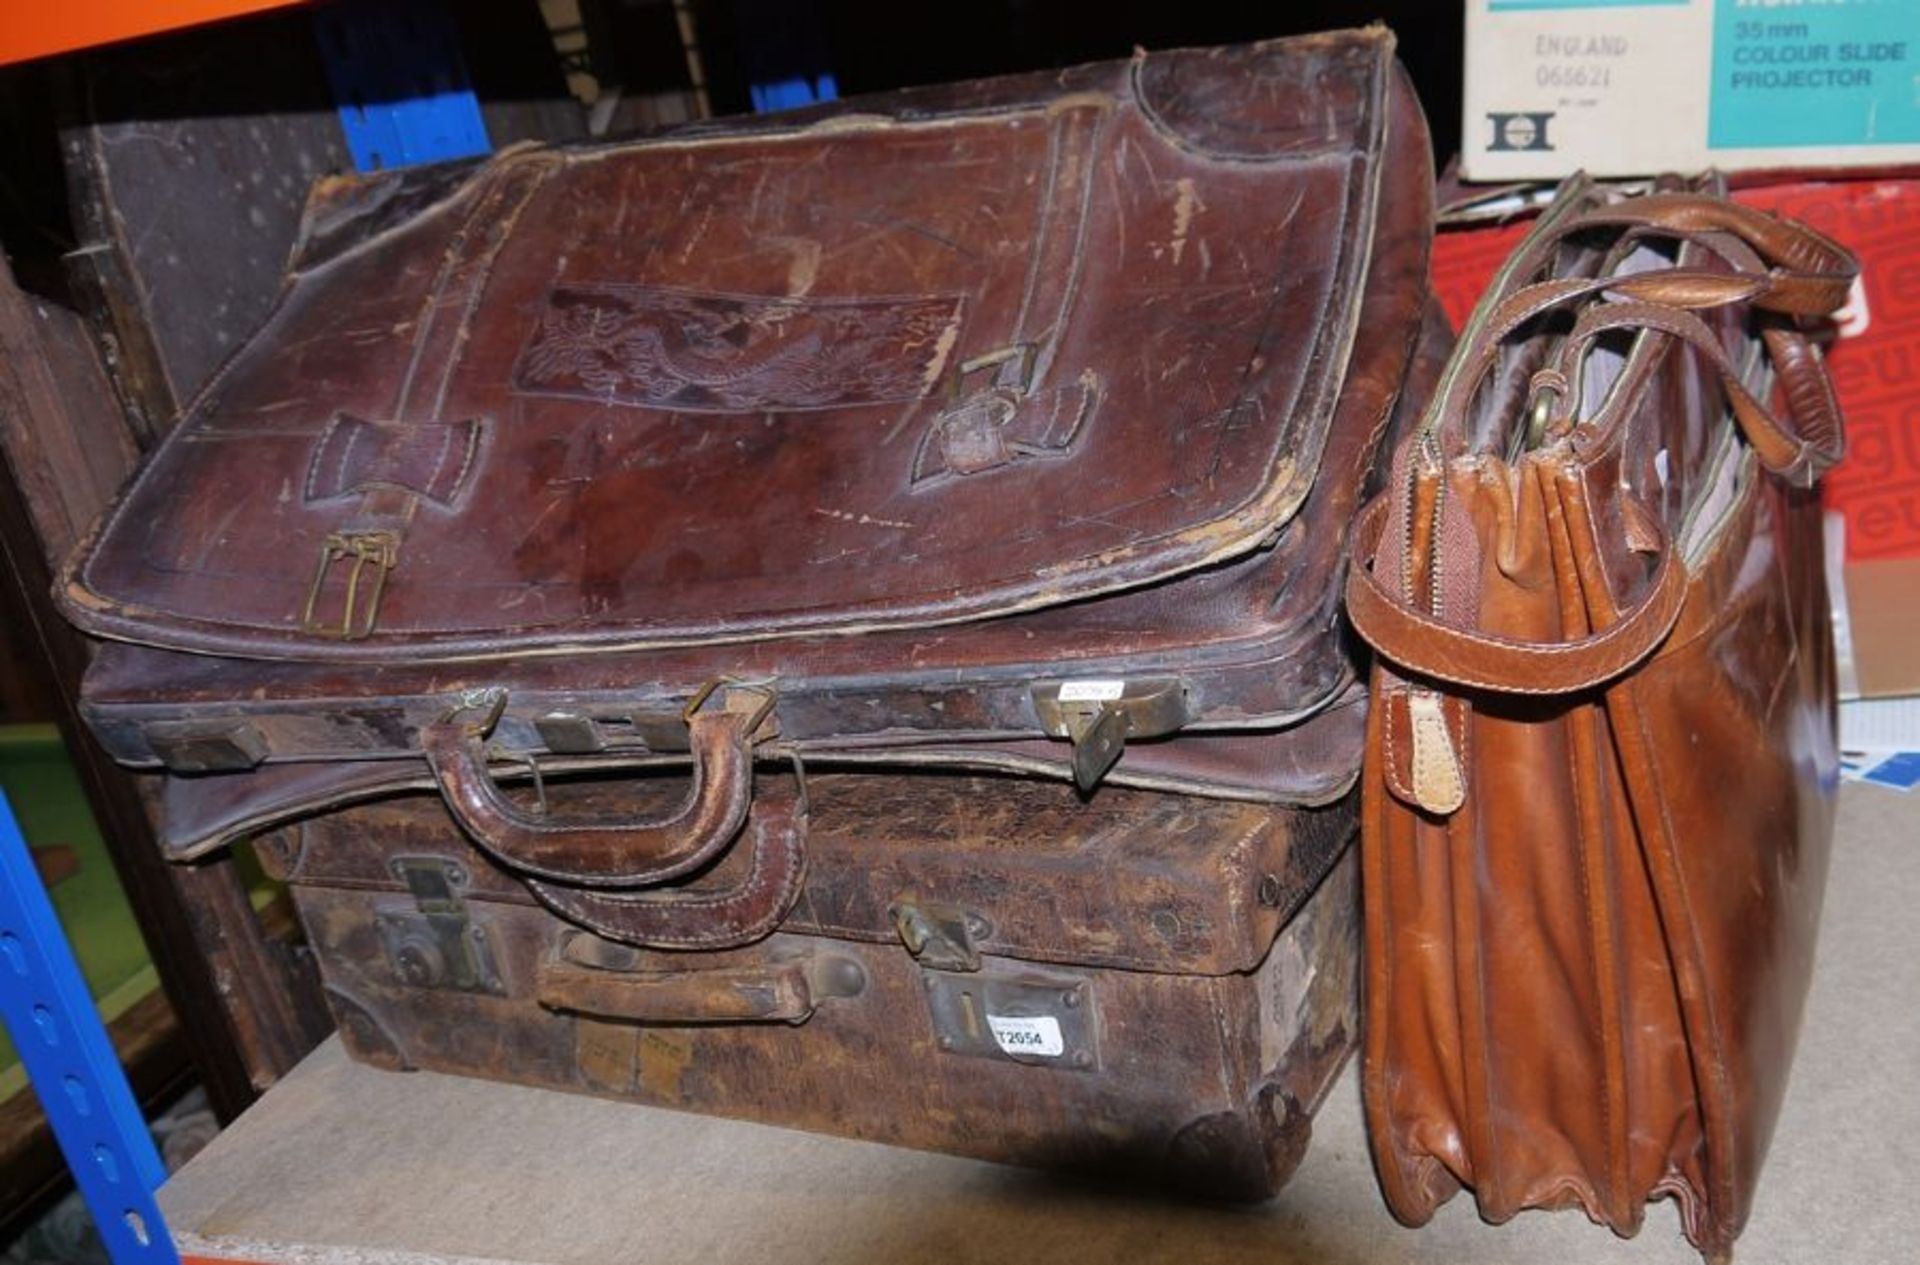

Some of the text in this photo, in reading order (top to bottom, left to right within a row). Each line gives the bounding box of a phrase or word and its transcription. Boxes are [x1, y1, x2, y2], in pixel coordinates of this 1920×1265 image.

[1535, 33, 1629, 56] ENGLAND
[1733, 41, 1907, 64] COLOUR SLIDE
[1732, 68, 1872, 89] PROJECTOR
[997, 1030, 1043, 1045] T2054
